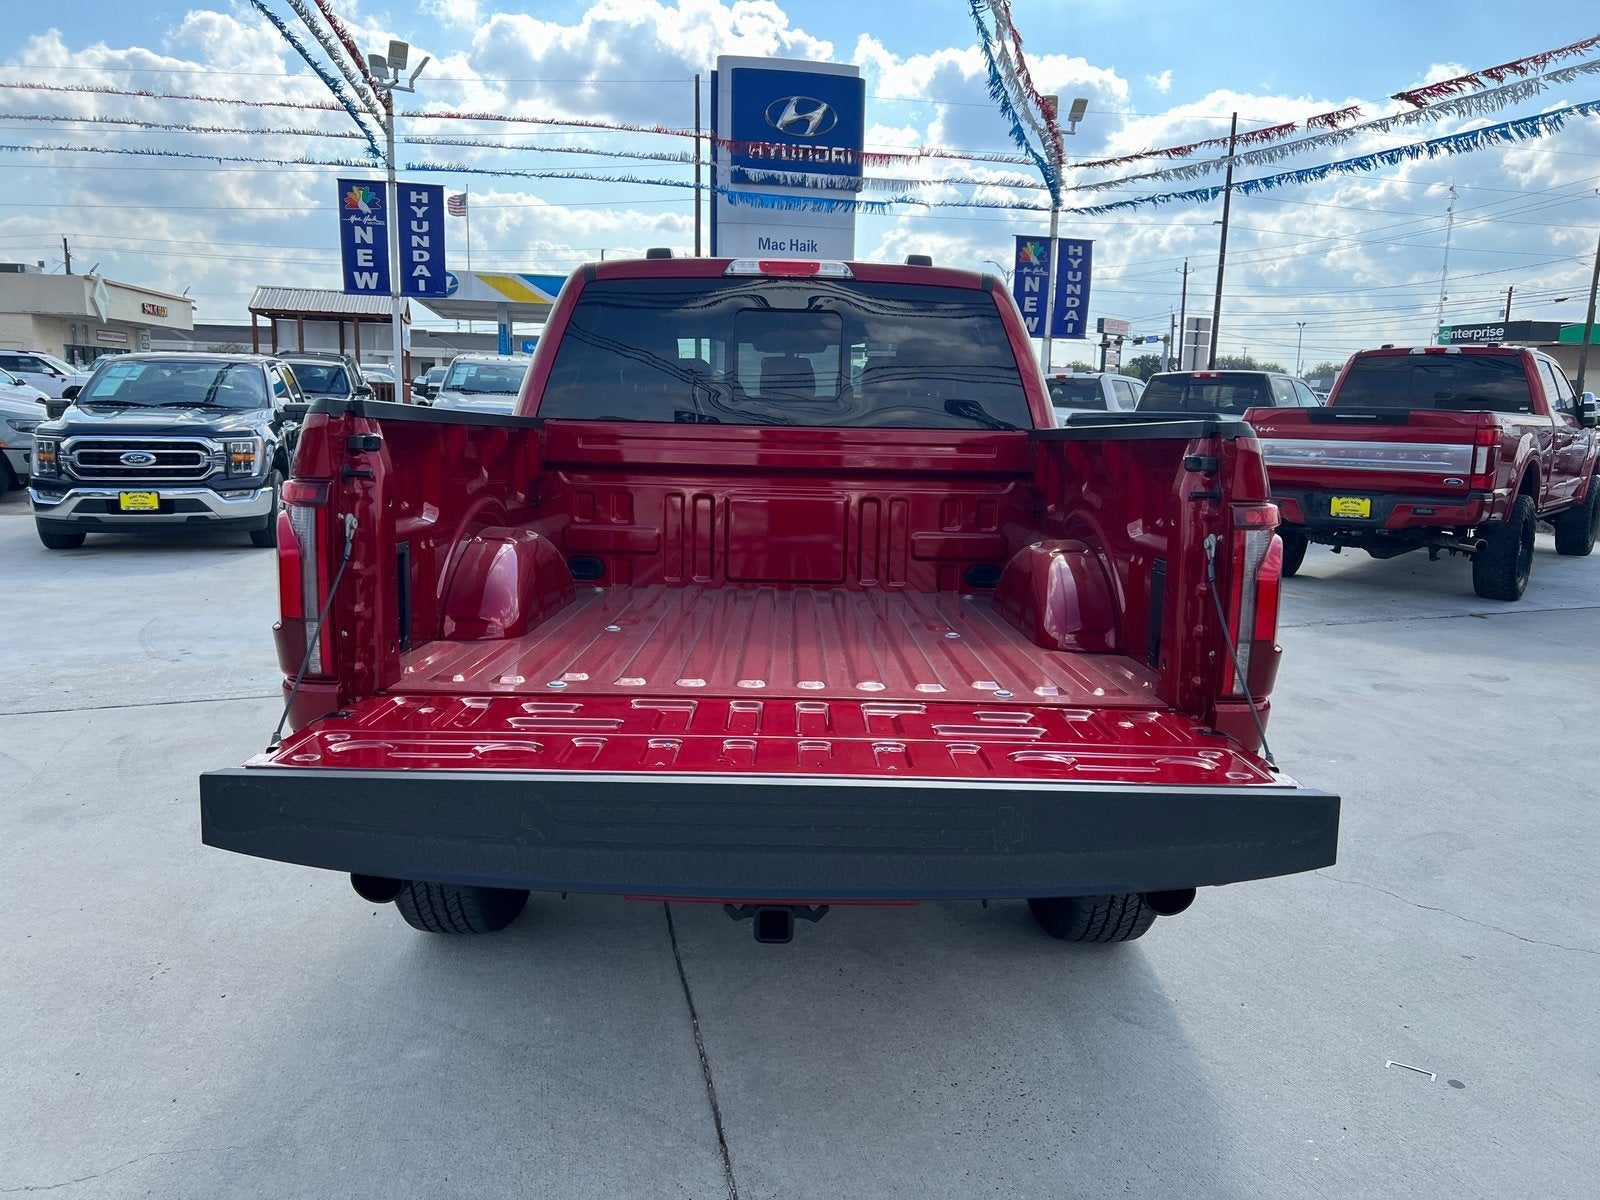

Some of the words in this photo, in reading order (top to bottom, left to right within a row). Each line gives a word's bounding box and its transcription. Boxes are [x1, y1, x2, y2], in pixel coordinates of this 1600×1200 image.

[353, 226, 379, 290] NEW
[409, 191, 432, 292] HYUNDAI
[758, 237, 786, 252] Mac
[789, 239, 818, 253] Haik
[1023, 276, 1040, 333] NEW
[1063, 245, 1083, 333] HYUNDAI
[1441, 326, 1504, 340] enterprise
